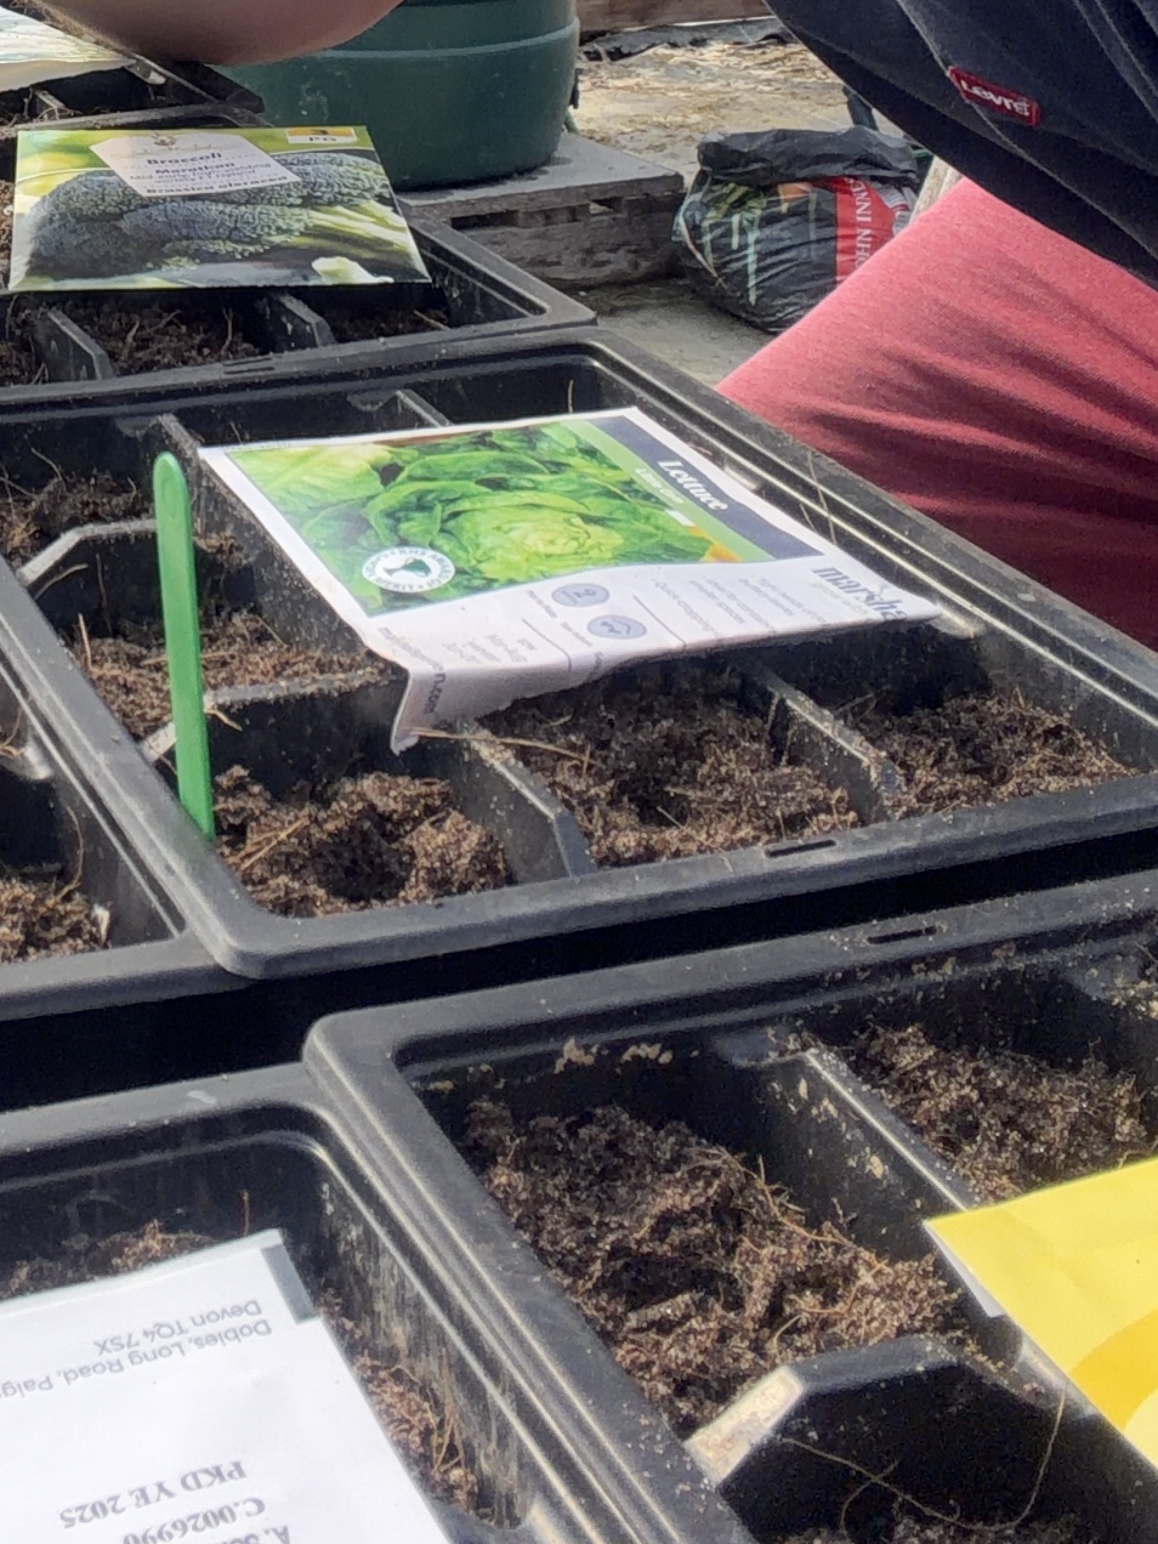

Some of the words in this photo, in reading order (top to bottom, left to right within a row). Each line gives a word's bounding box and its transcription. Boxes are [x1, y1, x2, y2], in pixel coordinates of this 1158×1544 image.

[855, 229, 871, 268] OHN
[658, 459, 728, 511] Lettuce
[190, 1299, 263, 1328] Devon
[93, 1333, 140, 1356] 7SX
[143, 1319, 189, 1342] TQ4
[188, 1319, 272, 1349] Dobies,
[128, 1341, 186, 1367] Long
[57, 1358, 125, 1385] Road,
[180, 1459, 248, 1492] PKD
[129, 1480, 177, 1509] YE
[59, 1494, 126, 1529] 2025
